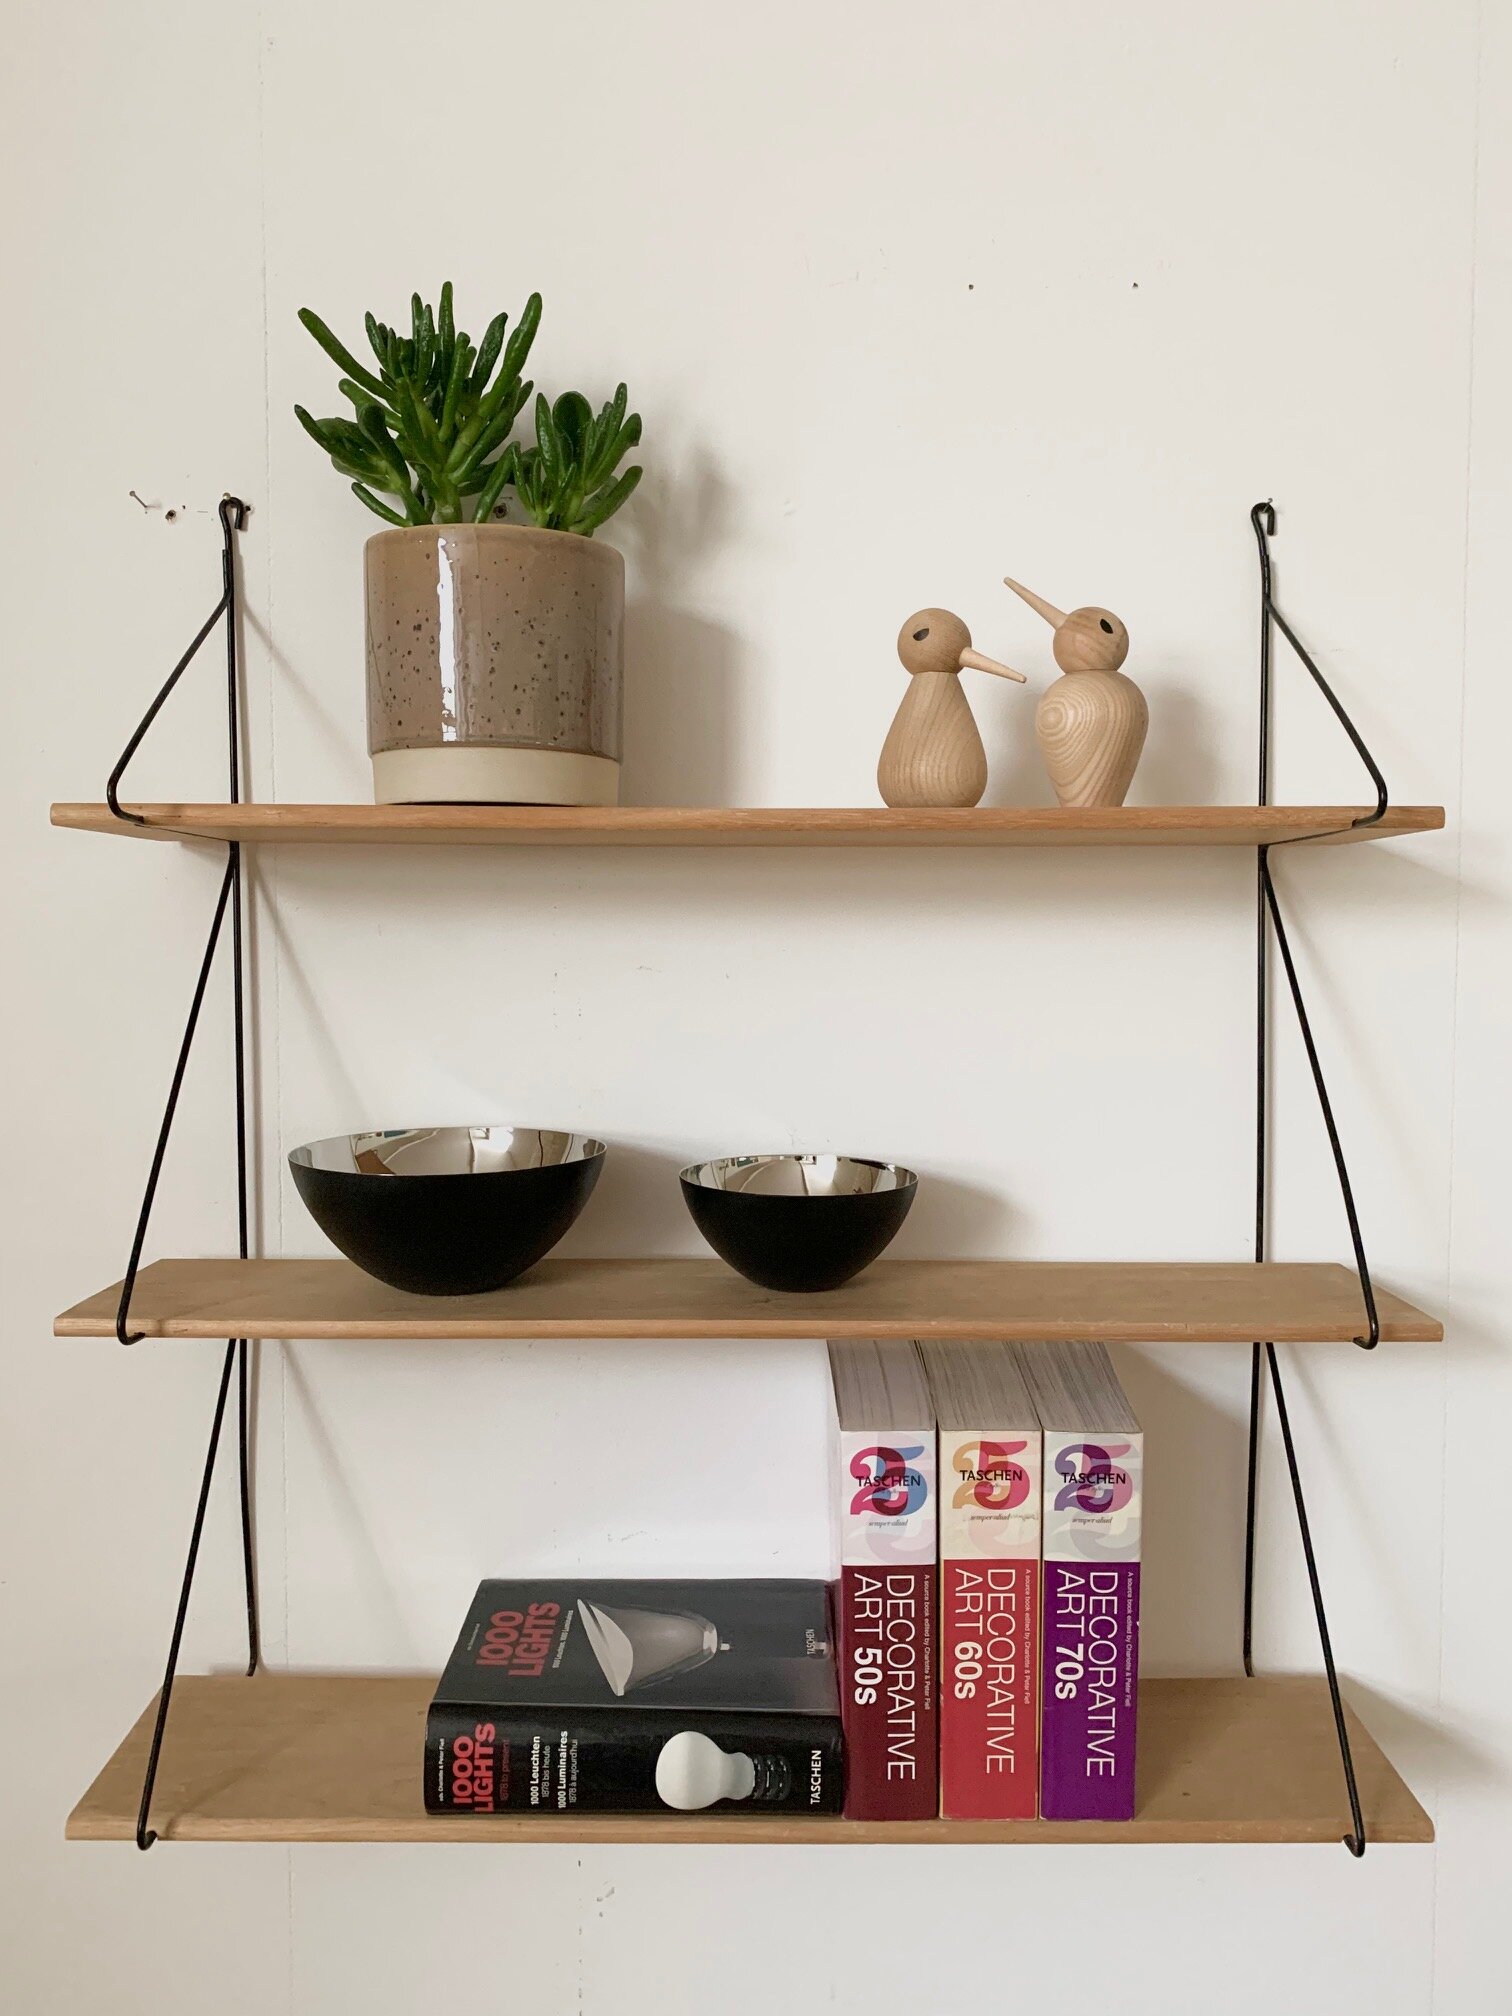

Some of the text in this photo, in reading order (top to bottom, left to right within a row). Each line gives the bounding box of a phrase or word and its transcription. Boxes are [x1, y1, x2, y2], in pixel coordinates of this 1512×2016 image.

[850, 1445, 927, 1516] 25
[856, 1475, 921, 1487] TASCHEN
[952, 1441, 1030, 1510] 25
[959, 1469, 1023, 1481] TASCHEN
[1054, 1444, 1133, 1513] 25
[1062, 1472, 1126, 1484] TASCHEN
[475, 1611, 524, 1666] 1000
[508, 1602, 560, 1676] LIGHTS
[805, 1629, 816, 1655] TASCHEN
[854, 1573, 883, 1705] ART 50s
[923, 1638, 930, 1646] by
[954, 1568, 983, 1699] ART 60s
[1023, 1632, 1029, 1640] by
[1055, 1569, 1085, 1700] ART 70s
[1125, 1635, 1132, 1643] by
[887, 1574, 916, 1780] DECORATIVE
[986, 1568, 1016, 1774] DECORATIVE
[1087, 1572, 1119, 1777] DECORATIVE
[452, 1735, 474, 1803] 1000
[473, 1723, 496, 1812] LIGHTS
[530, 1736, 541, 1805] 1000 Leuchten
[541, 1745, 551, 1797] 1878 bis heute
[557, 1731, 568, 1808] 1000 Luminaires
[569, 1788, 577, 1803] 1878
[810, 1750, 822, 1805] TASCHEN
